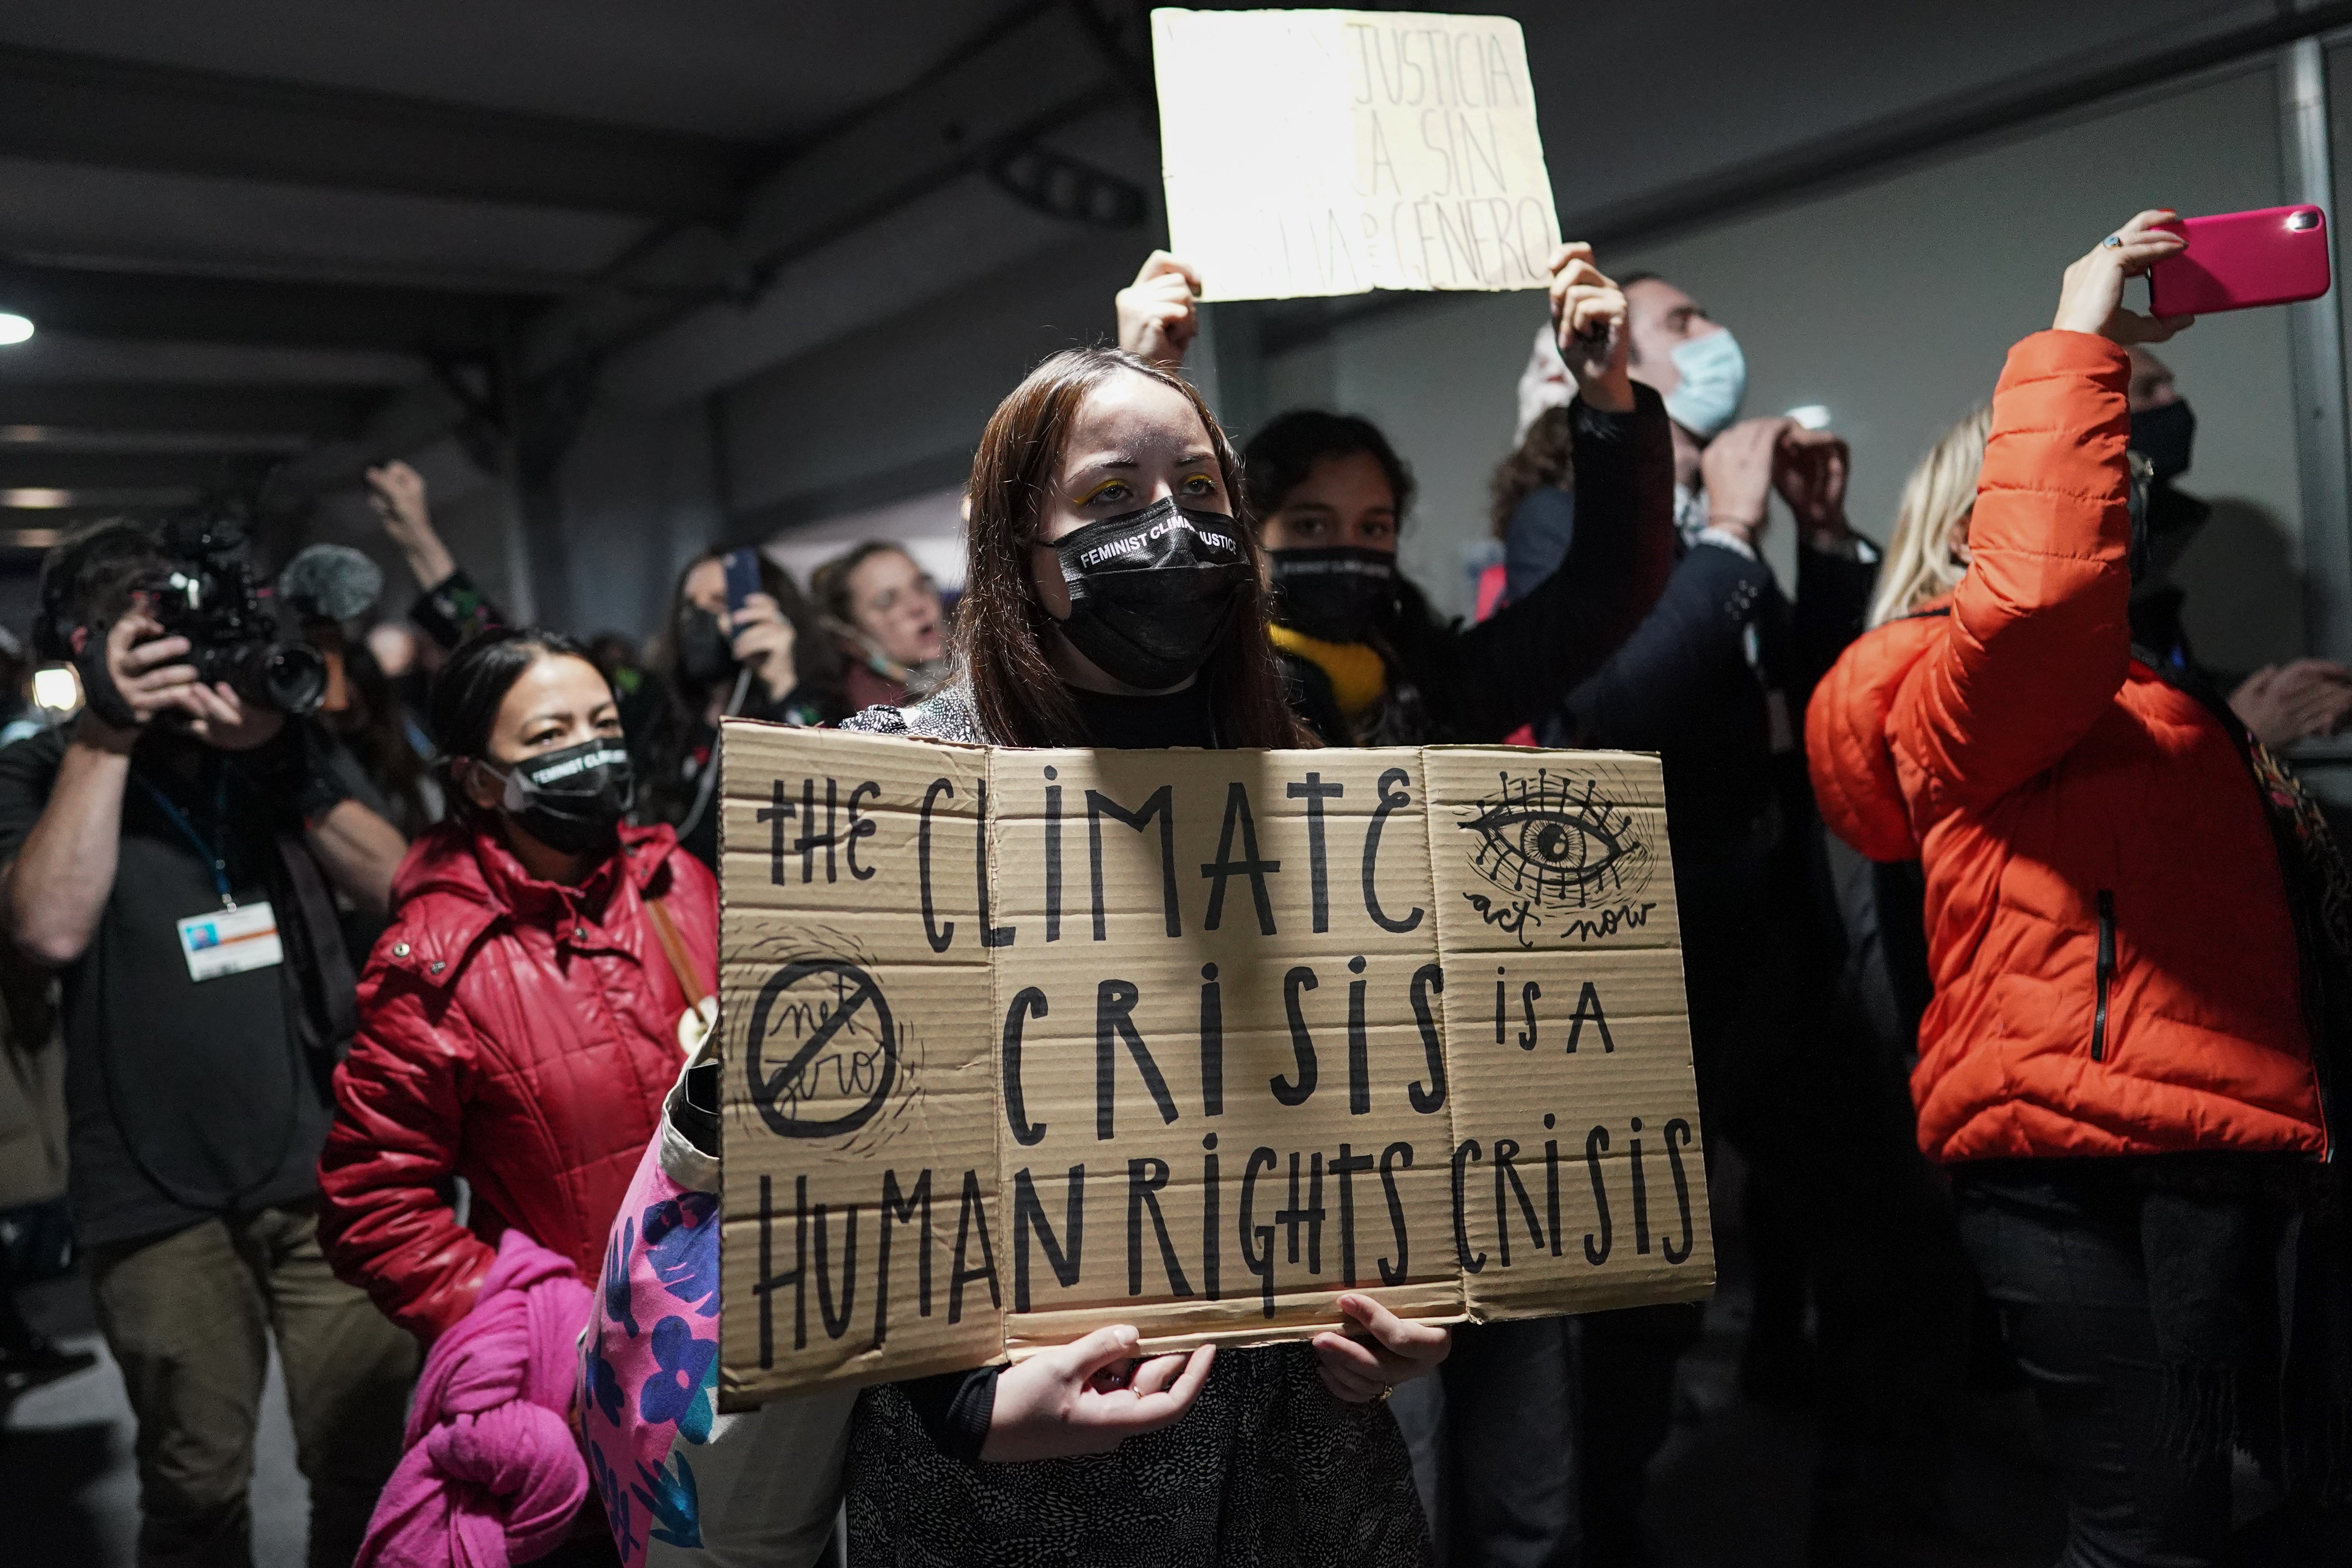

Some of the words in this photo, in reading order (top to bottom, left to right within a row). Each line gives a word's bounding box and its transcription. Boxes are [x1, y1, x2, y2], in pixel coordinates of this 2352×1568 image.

[1346, 23, 1519, 107] JUSTICIA
[1419, 107, 1508, 197] SIN
[1081, 532, 1148, 569] FEMINIST
[1150, 515, 1196, 540] CLIMA
[1462, 892, 1541, 947] act
[1561, 903, 1657, 942] now
[1566, 981, 1614, 1053] A
[752, 1164, 1085, 1370] HUMAN
